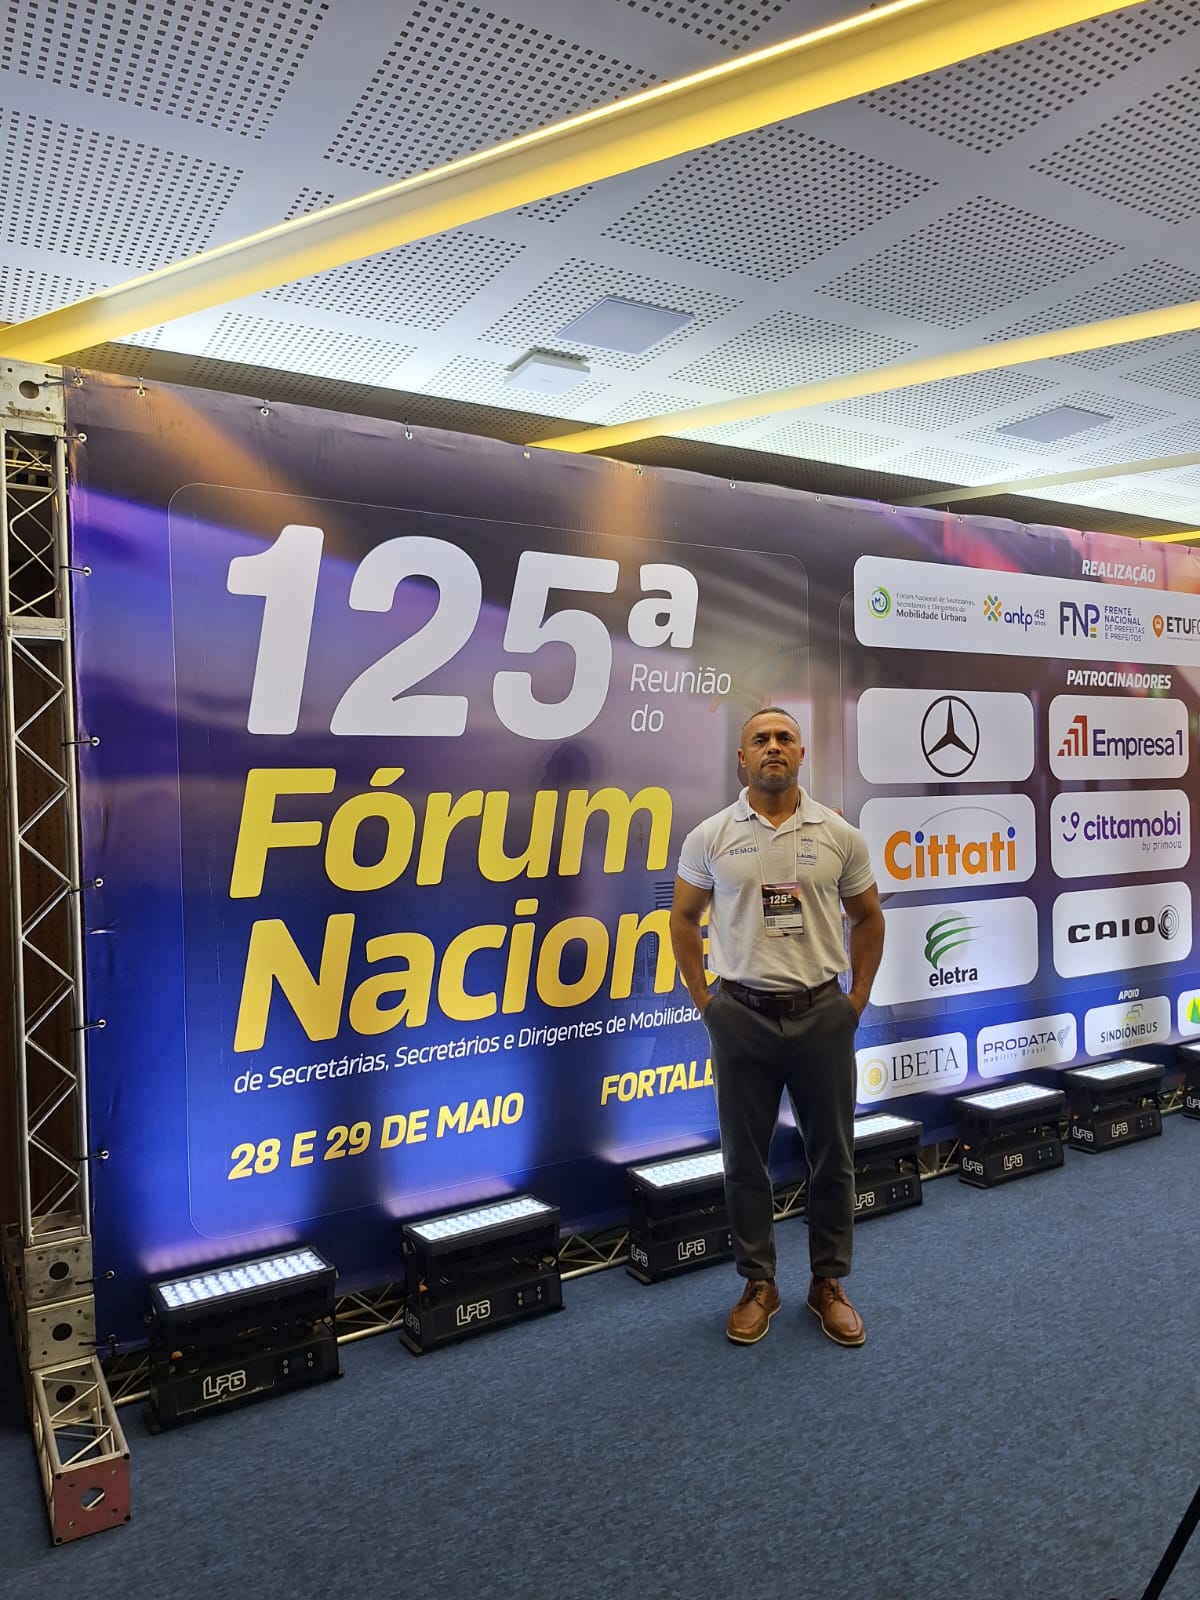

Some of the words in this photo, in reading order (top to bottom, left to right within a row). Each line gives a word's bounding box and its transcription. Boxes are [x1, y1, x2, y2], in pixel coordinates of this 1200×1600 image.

[1082, 559, 1156, 585] REALIZAÇÃO
[896, 609, 940, 621] Mobilidade
[940, 612, 967, 623] Urbana
[1004, 606, 1033, 632] antp
[1034, 609, 1045, 619] 49
[1060, 601, 1100, 638] FNP
[1104, 605, 1132, 616] FRENTE
[1104, 615, 1142, 626] NACIONAL
[1110, 633, 1142, 642] PREFEITOS
[1114, 626, 1145, 635] PREFEITAS
[630, 663, 732, 696] Reunião
[1066, 669, 1172, 691] PATROCINADORES
[631, 704, 664, 733] do
[229, 767, 674, 899] Fórum
[1083, 810, 1181, 842] cittamobi
[884, 826, 1016, 881] Cittati
[1142, 842, 1151, 853] by
[1068, 916, 1156, 945] CAIO
[233, 898, 722, 1053] Nacion
[929, 966, 979, 987] eletra
[1118, 988, 1140, 1001] APOIO
[233, 1071, 263, 1094] de
[267, 1053, 389, 1089] Secretárias,
[394, 1037, 500, 1068] Secretários
[503, 1034, 514, 1050] e
[518, 1018, 602, 1049] Dirigentes
[606, 1015, 626, 1035] de
[983, 1032, 1057, 1056] PRODATA
[983, 1052, 1018, 1064] mobility
[1021, 1045, 1047, 1057] Brasil
[891, 1047, 960, 1082] IBETA
[1186, 1095, 1200, 1109] LP
[228, 1138, 281, 1180] 28
[290, 1130, 317, 1168] E
[323, 1120, 372, 1161] 29
[380, 1109, 430, 1150] DE
[436, 1092, 525, 1138] MAIO
[677, 1238, 706, 1261] LPG
[456, 1300, 492, 1326] LPG
[203, 1370, 247, 1400] LPG
